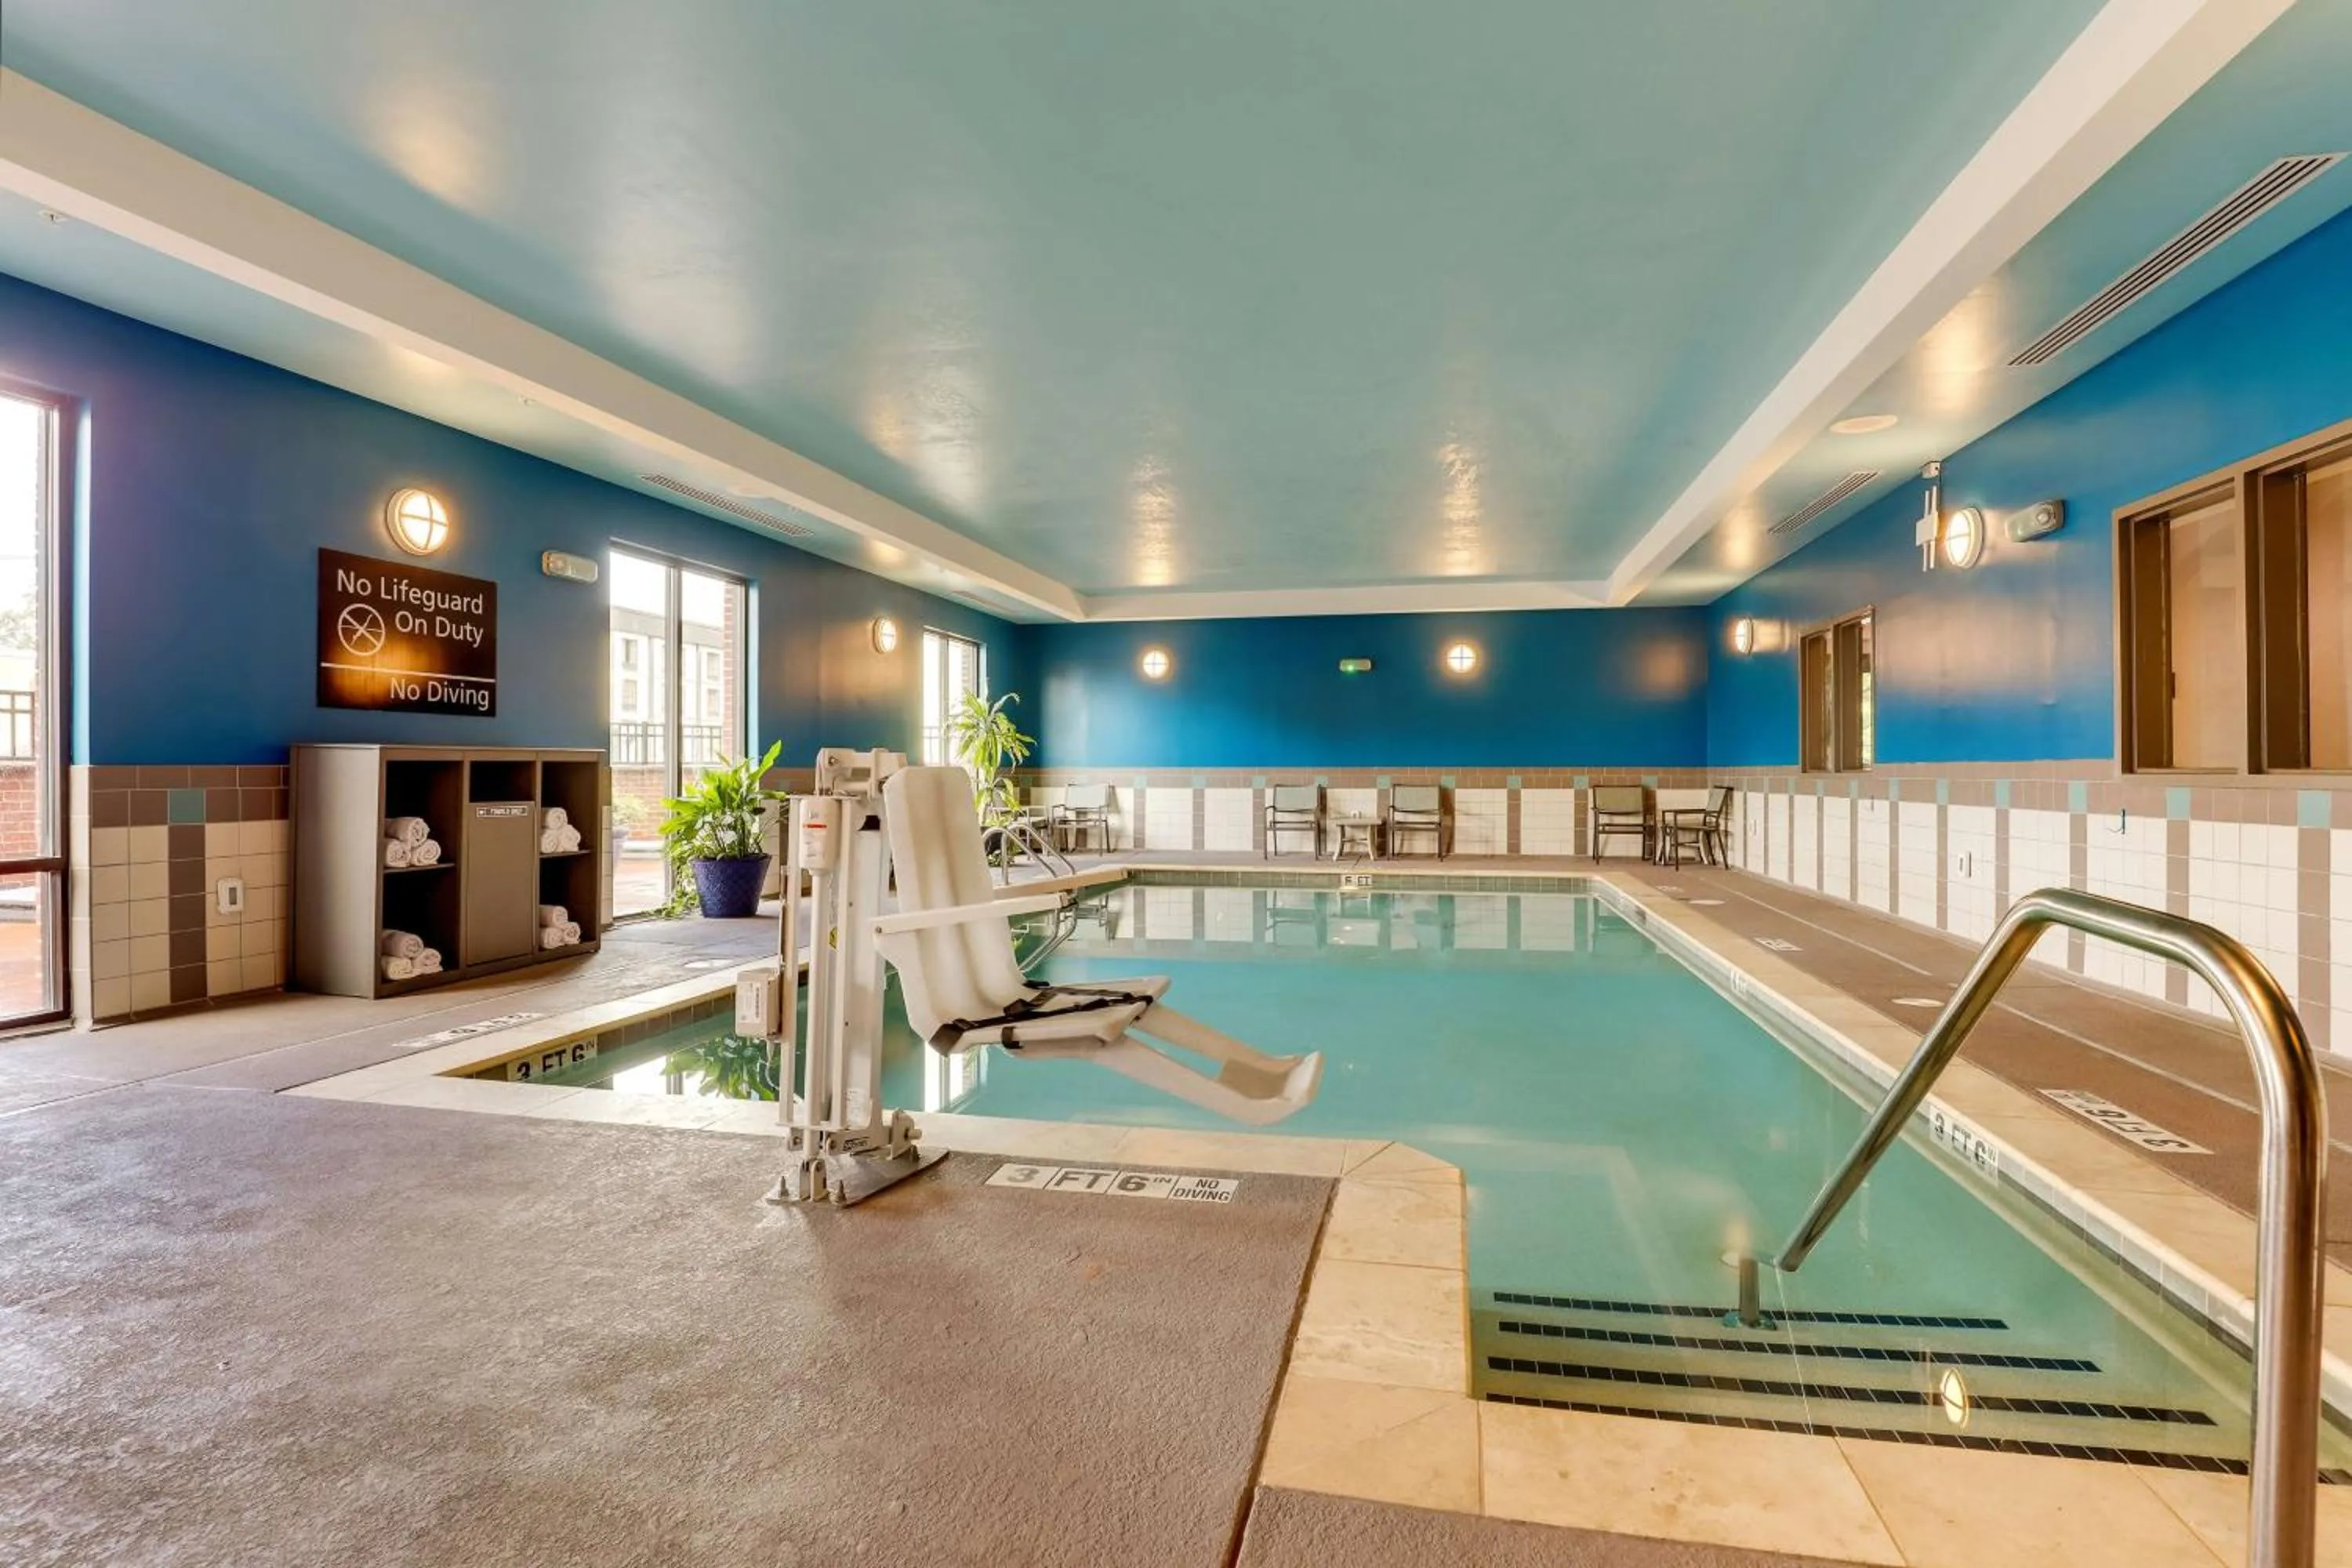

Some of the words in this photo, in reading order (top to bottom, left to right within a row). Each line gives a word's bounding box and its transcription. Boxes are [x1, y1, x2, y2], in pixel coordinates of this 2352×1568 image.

[337, 568, 372, 596] No
[380, 576, 483, 615] Lifeguard
[395, 611, 427, 635] On
[435, 616, 484, 648] Duty
[390, 677, 420, 700] No
[427, 681, 489, 711] Diving
[542, 1048, 567, 1073] FT
[1006, 1167, 1040, 1183] 3
[1053, 1170, 1112, 1189] FT
[1116, 1174, 1150, 1192] 6
[1195, 1178, 1219, 1189] NO
[1173, 1187, 1231, 1202] DIVING
